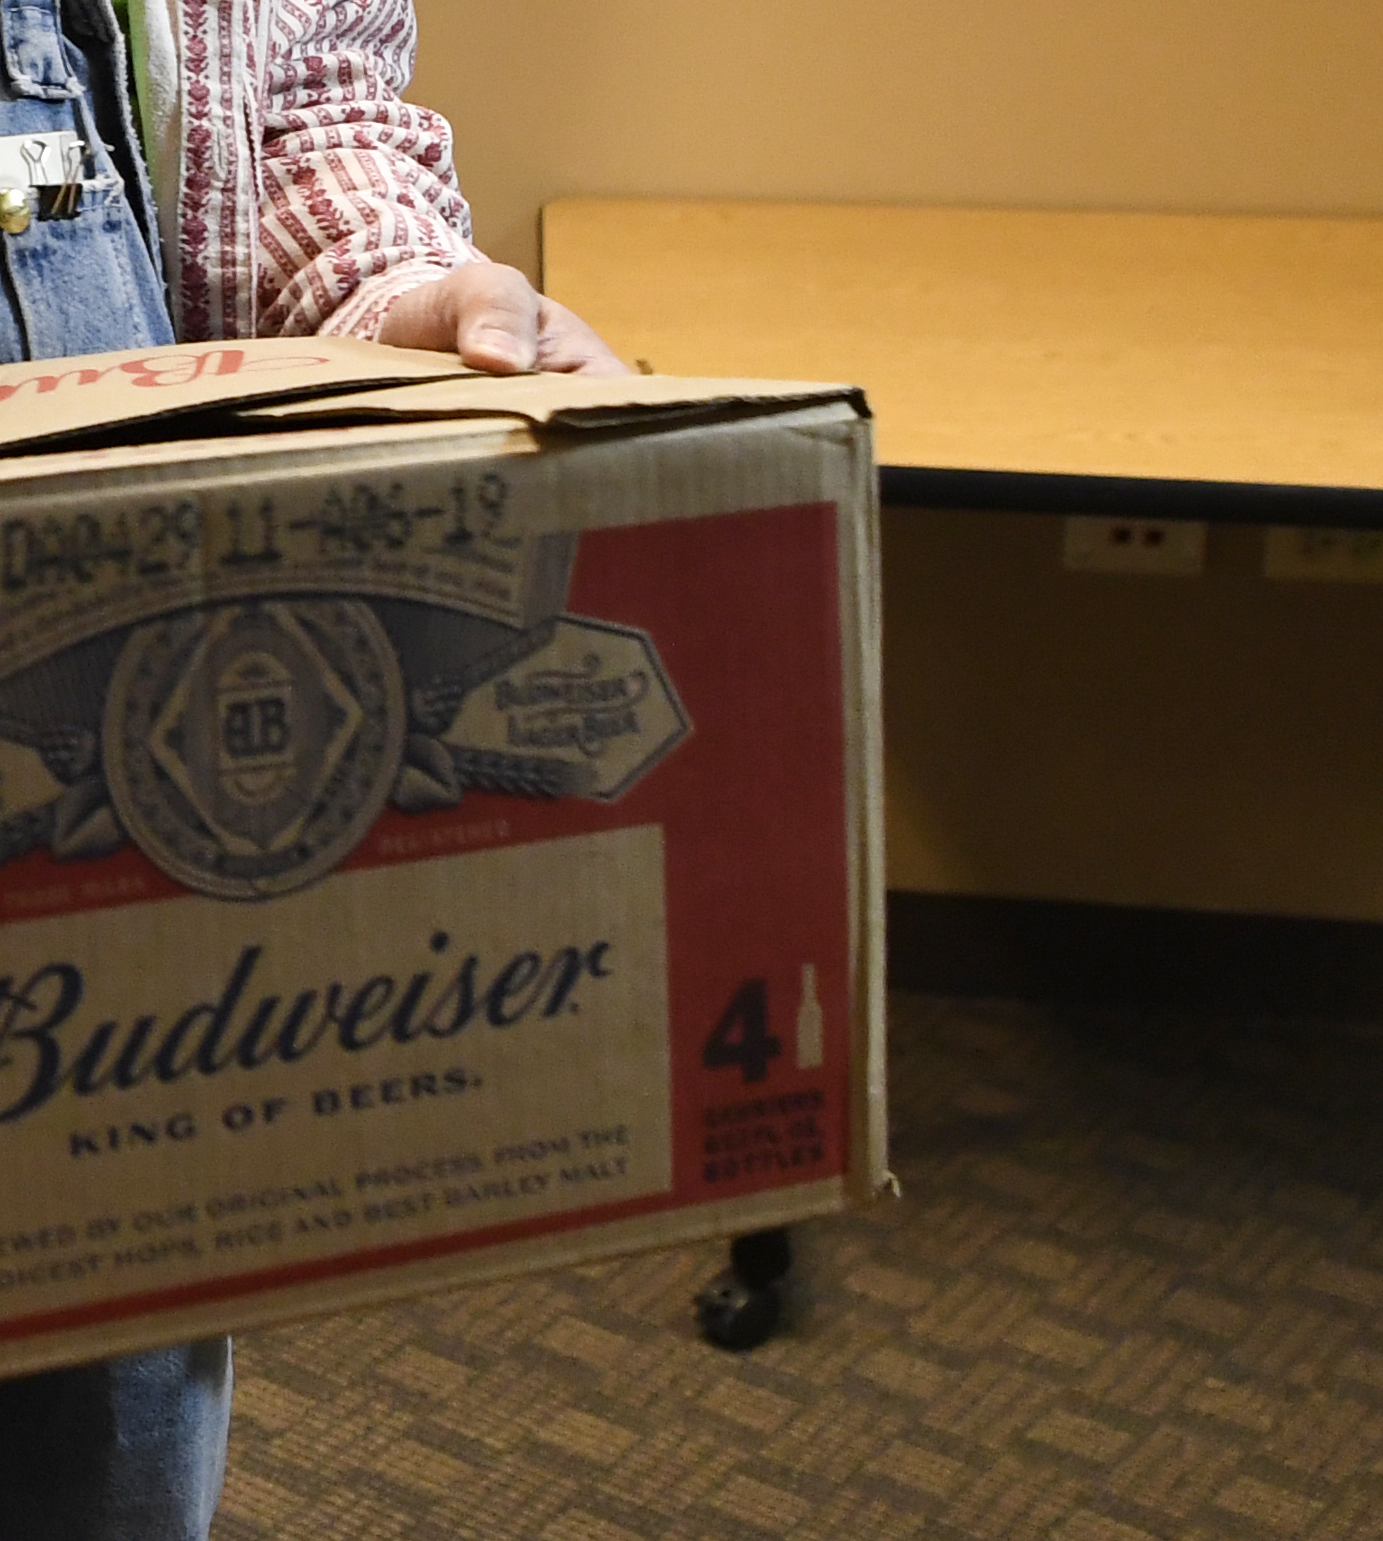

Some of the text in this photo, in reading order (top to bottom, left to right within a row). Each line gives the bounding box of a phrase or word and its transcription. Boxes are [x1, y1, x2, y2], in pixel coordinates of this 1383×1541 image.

[702, 978, 782, 1084] 4
[67, 1066, 485, 1159] KING OF BEERS.
[131, 1202, 199, 1233] OUR
